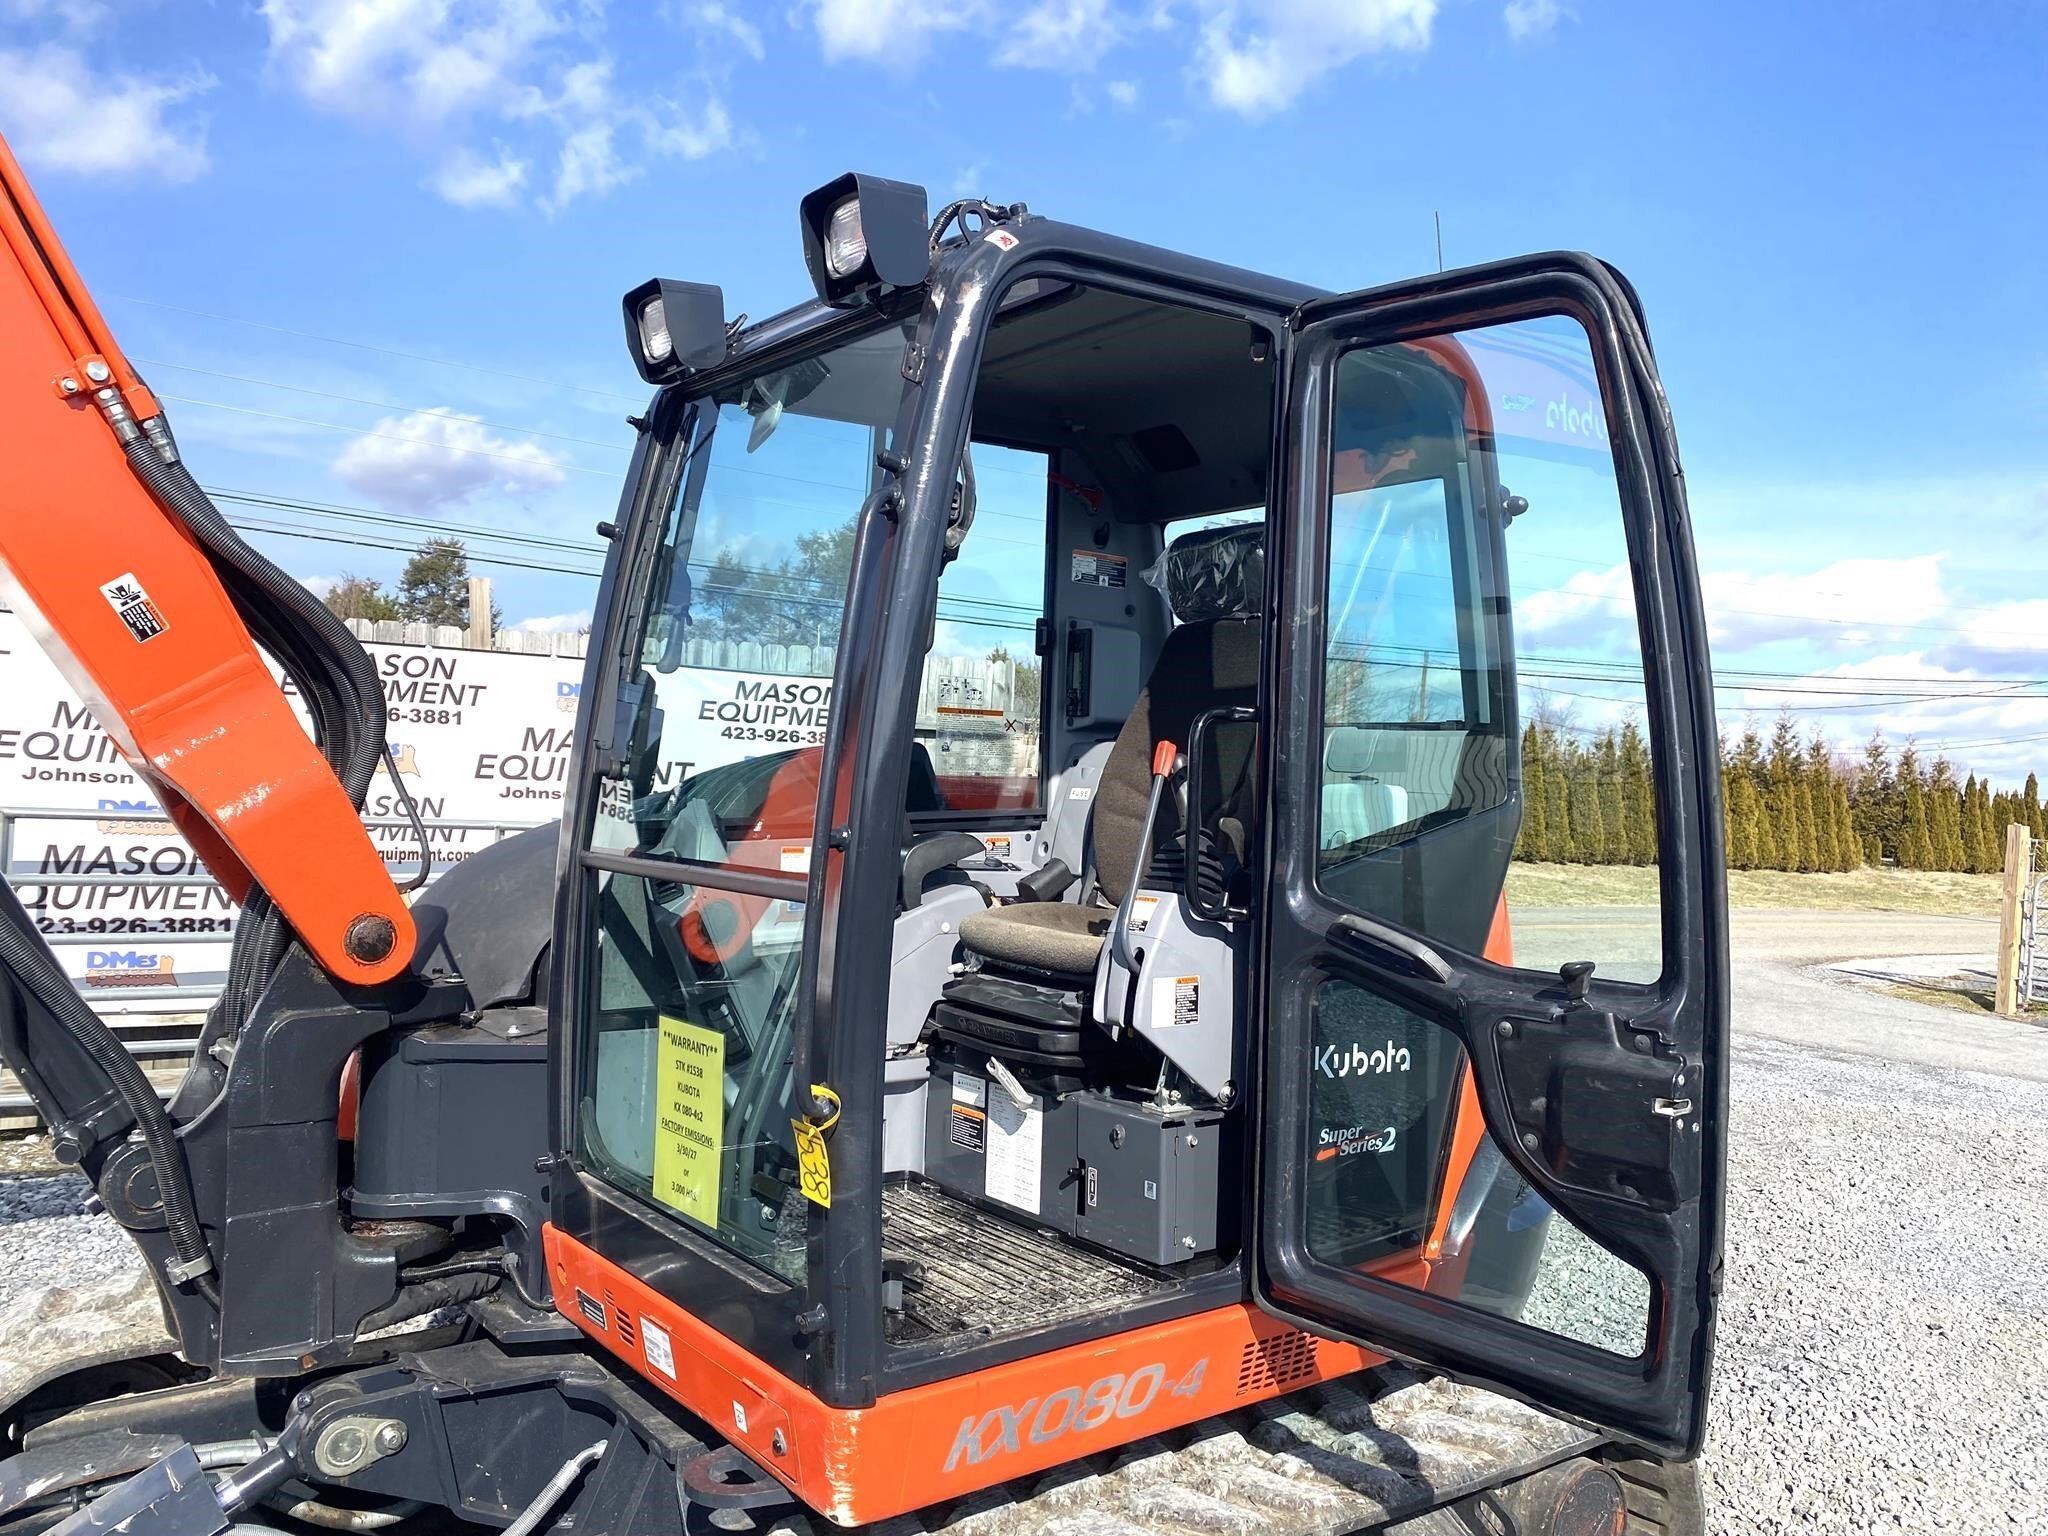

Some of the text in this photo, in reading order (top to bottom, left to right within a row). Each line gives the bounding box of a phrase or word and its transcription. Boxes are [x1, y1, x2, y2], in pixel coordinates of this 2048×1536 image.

[698, 700, 829, 727] EQUIPME
[721, 726, 826, 744] 423-926-38
[21, 766, 134, 784] Johnson
[499, 786, 567, 800] Johns
[675, 1059, 686, 1072] STK
[1314, 1040, 1411, 1078] Kubota
[677, 1082, 701, 1099] KUBOTA
[673, 1101, 682, 1114] KX
[661, 1117, 685, 1134] FACTORY
[1319, 1126, 1363, 1145] Super
[676, 1143, 698, 1160] 3/30/27
[683, 1169, 690, 1177] or
[671, 1181, 686, 1197] 3,000
[941, 1358, 1209, 1474] KX080-4
